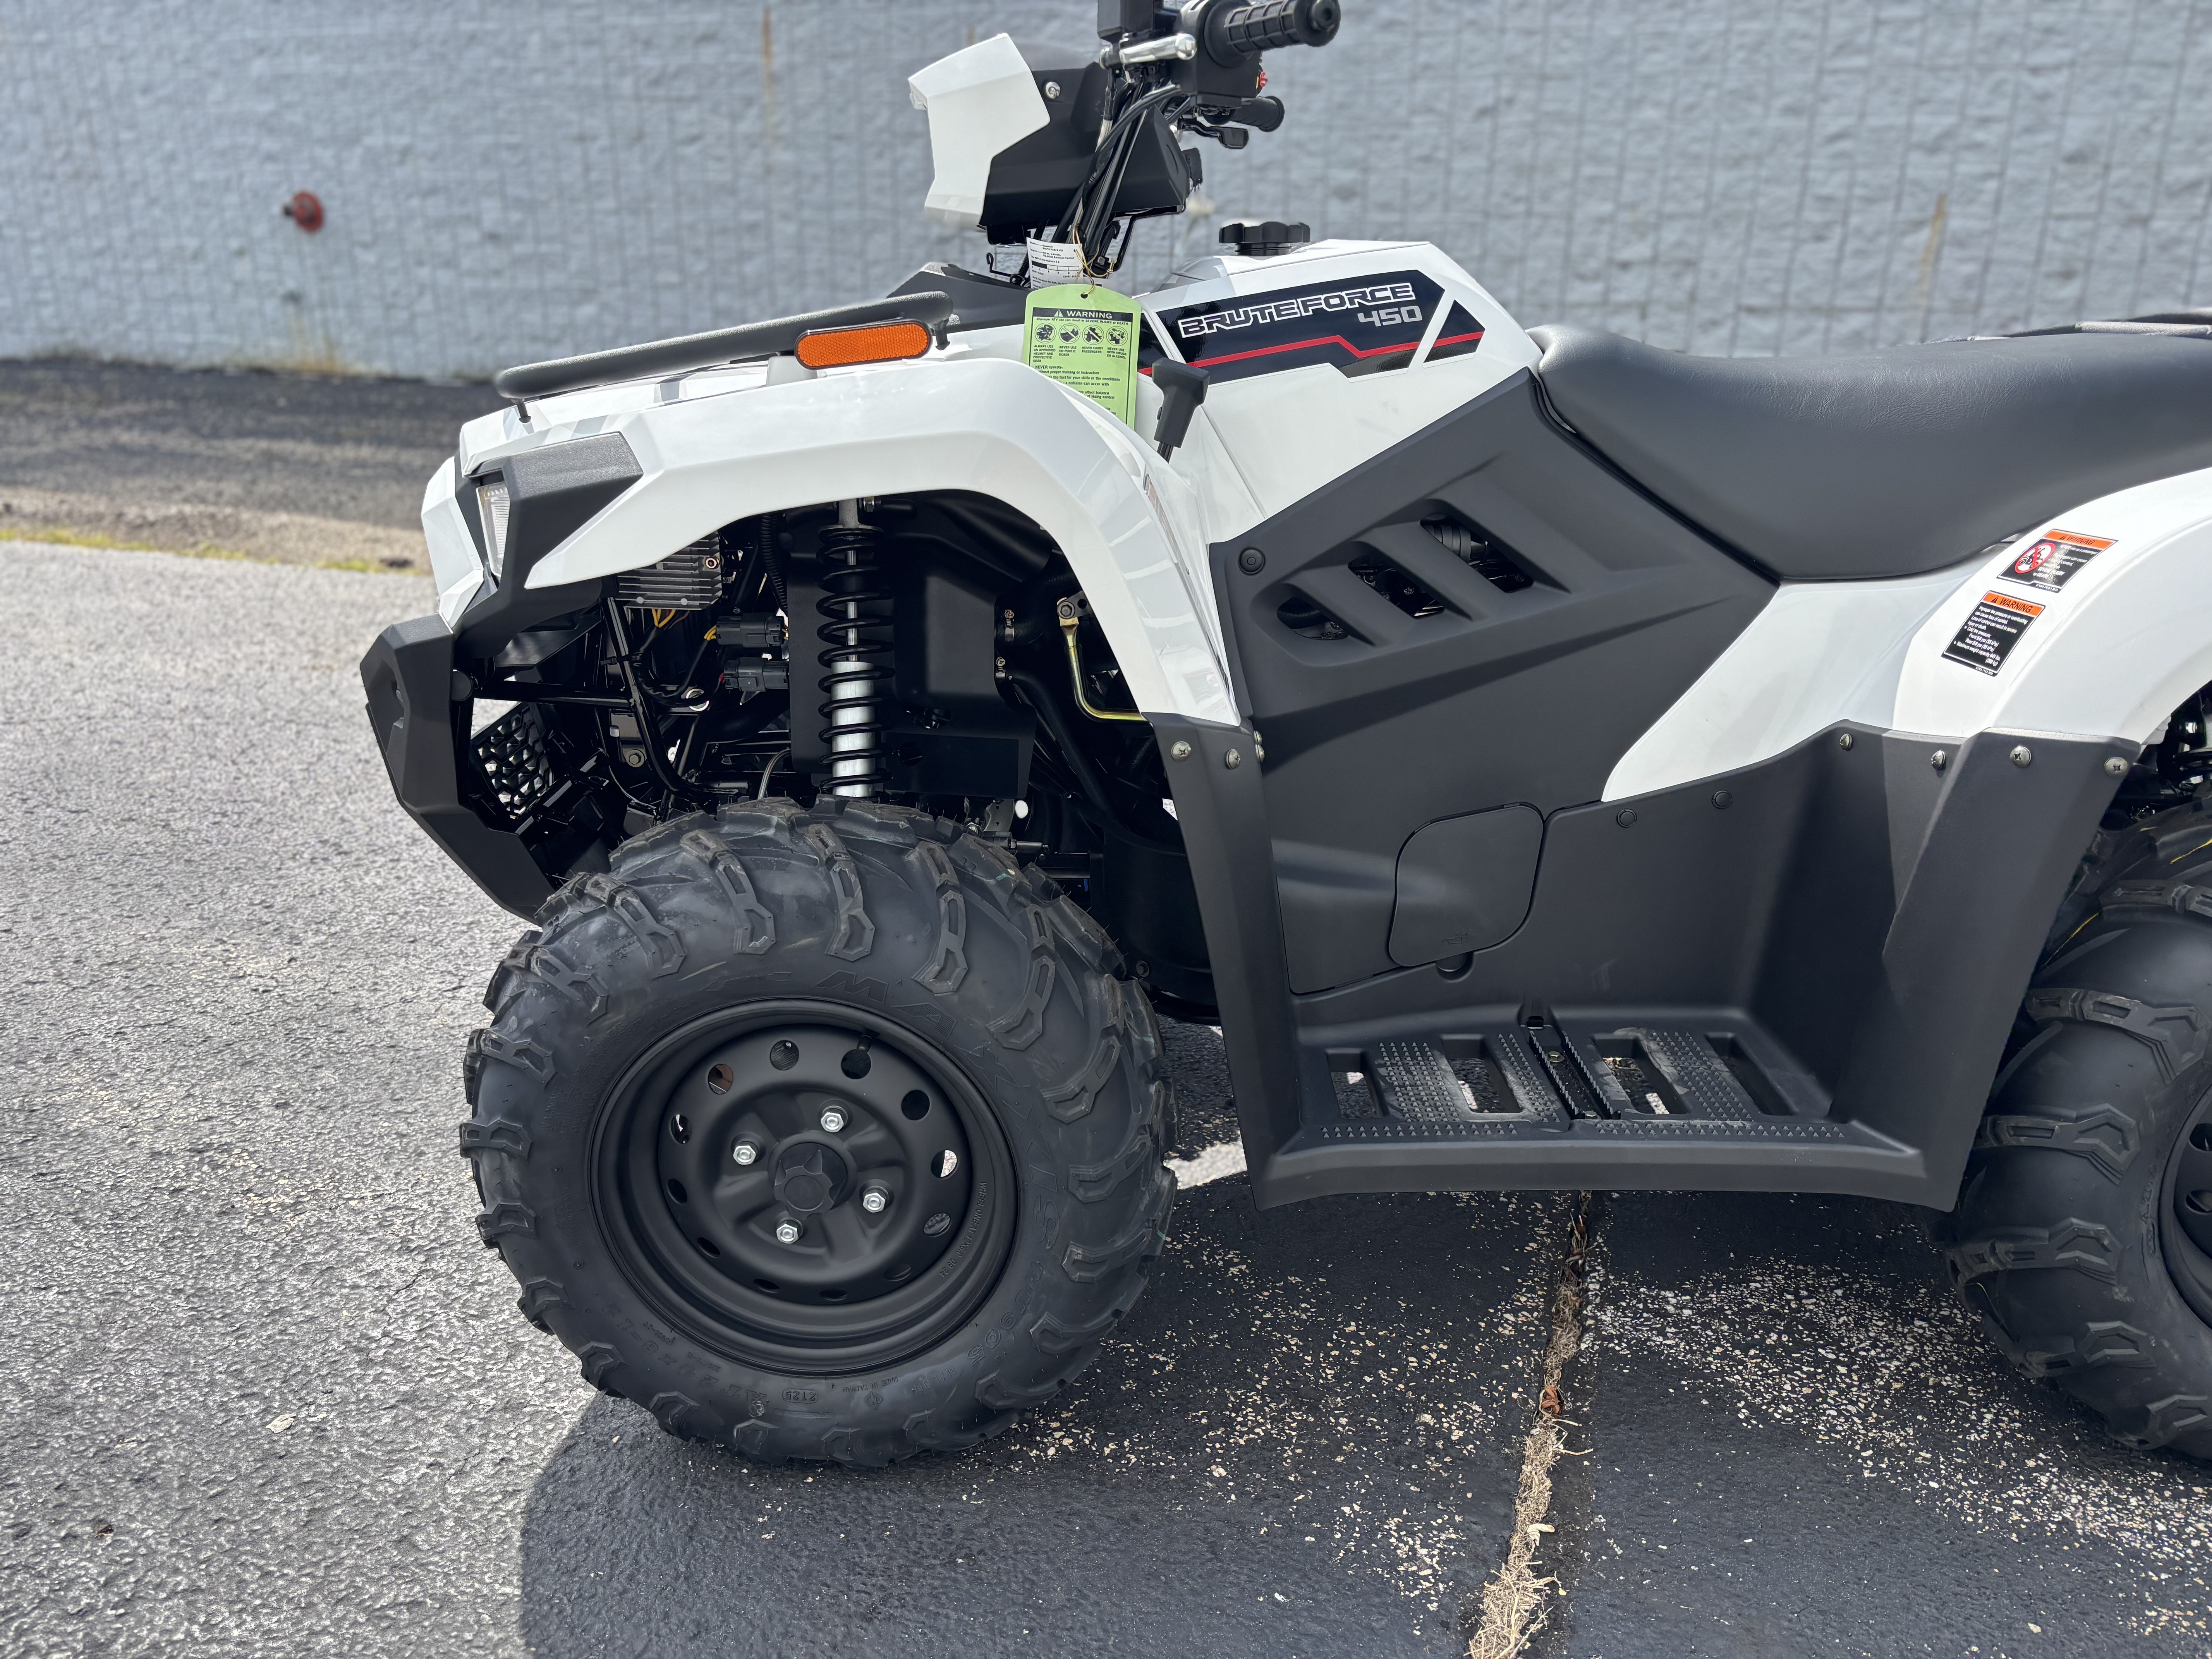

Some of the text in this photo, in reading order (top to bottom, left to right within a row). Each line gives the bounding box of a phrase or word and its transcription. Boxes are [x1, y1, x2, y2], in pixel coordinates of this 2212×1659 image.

[1067, 311, 1112, 319] WARNING
[1177, 282, 1416, 338] BRUTE FORCE
[1357, 305, 1423, 327] 450
[1999, 599, 2032, 612] WARNING
[814, 970, 1060, 1250] MAXXIS
[977, 1182, 987, 1207] WHEEL
[940, 1266, 949, 1278] 24
[842, 1382, 869, 1394] TAIWAN
[911, 1366, 956, 1396] NYLON
[785, 1391, 816, 1402] 2125
